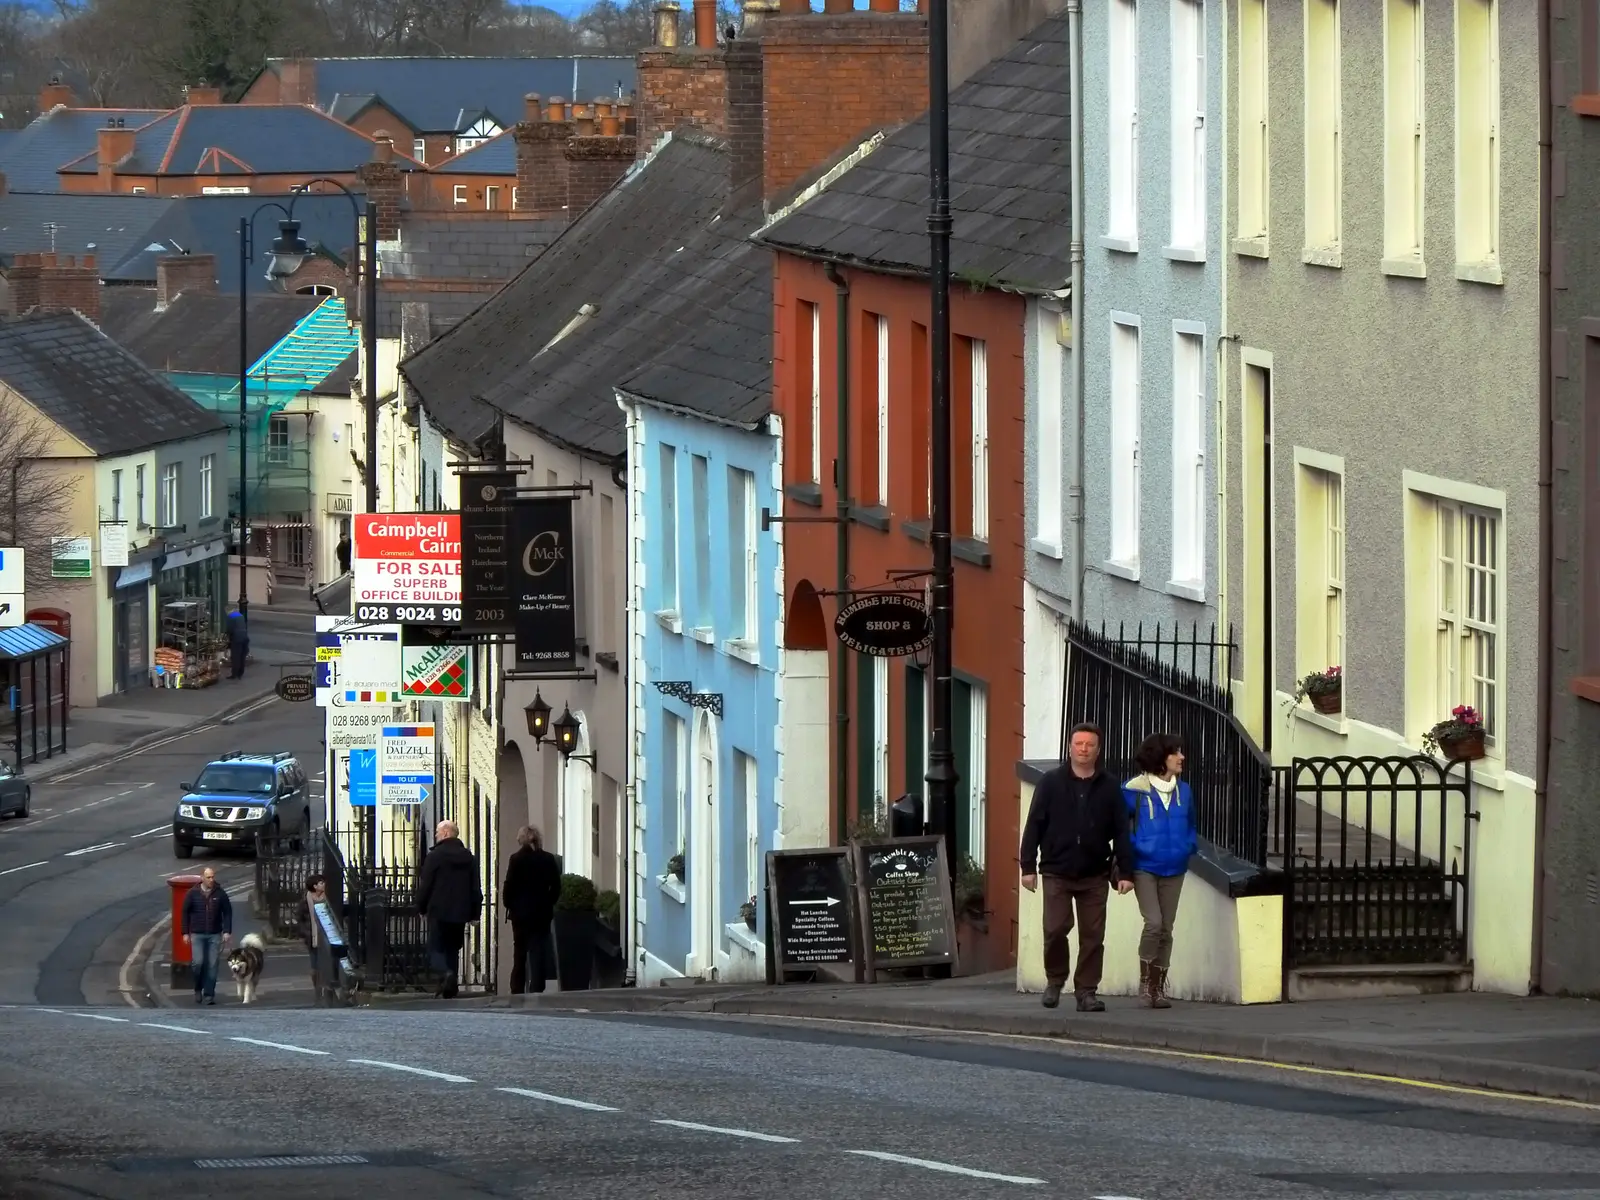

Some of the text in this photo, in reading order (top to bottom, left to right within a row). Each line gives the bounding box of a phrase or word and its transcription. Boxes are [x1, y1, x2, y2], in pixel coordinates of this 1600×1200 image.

[367, 521, 448, 540] Campbell
[474, 533, 504, 541] Northern
[380, 549, 415, 557] Commercial
[478, 546, 501, 554] Ireland
[376, 562, 462, 576] FOR SALE
[393, 578, 448, 589] SUPERB
[361, 590, 408, 600] OFFICE
[538, 593, 567, 602] McKinney
[552, 603, 571, 611] Beauty
[836, 596, 880, 626] HUMBLE
[881, 596, 901, 605] PIE
[358, 606, 462, 621] 028 9024 90
[475, 609, 505, 621] 2003
[866, 621, 911, 631] SHOP &
[553, 651, 570, 659] 8858
[332, 715, 348, 726] 028
[350, 715, 369, 726] 9268
[386, 746, 430, 754] DALZELL
[881, 848, 907, 864] Humble
